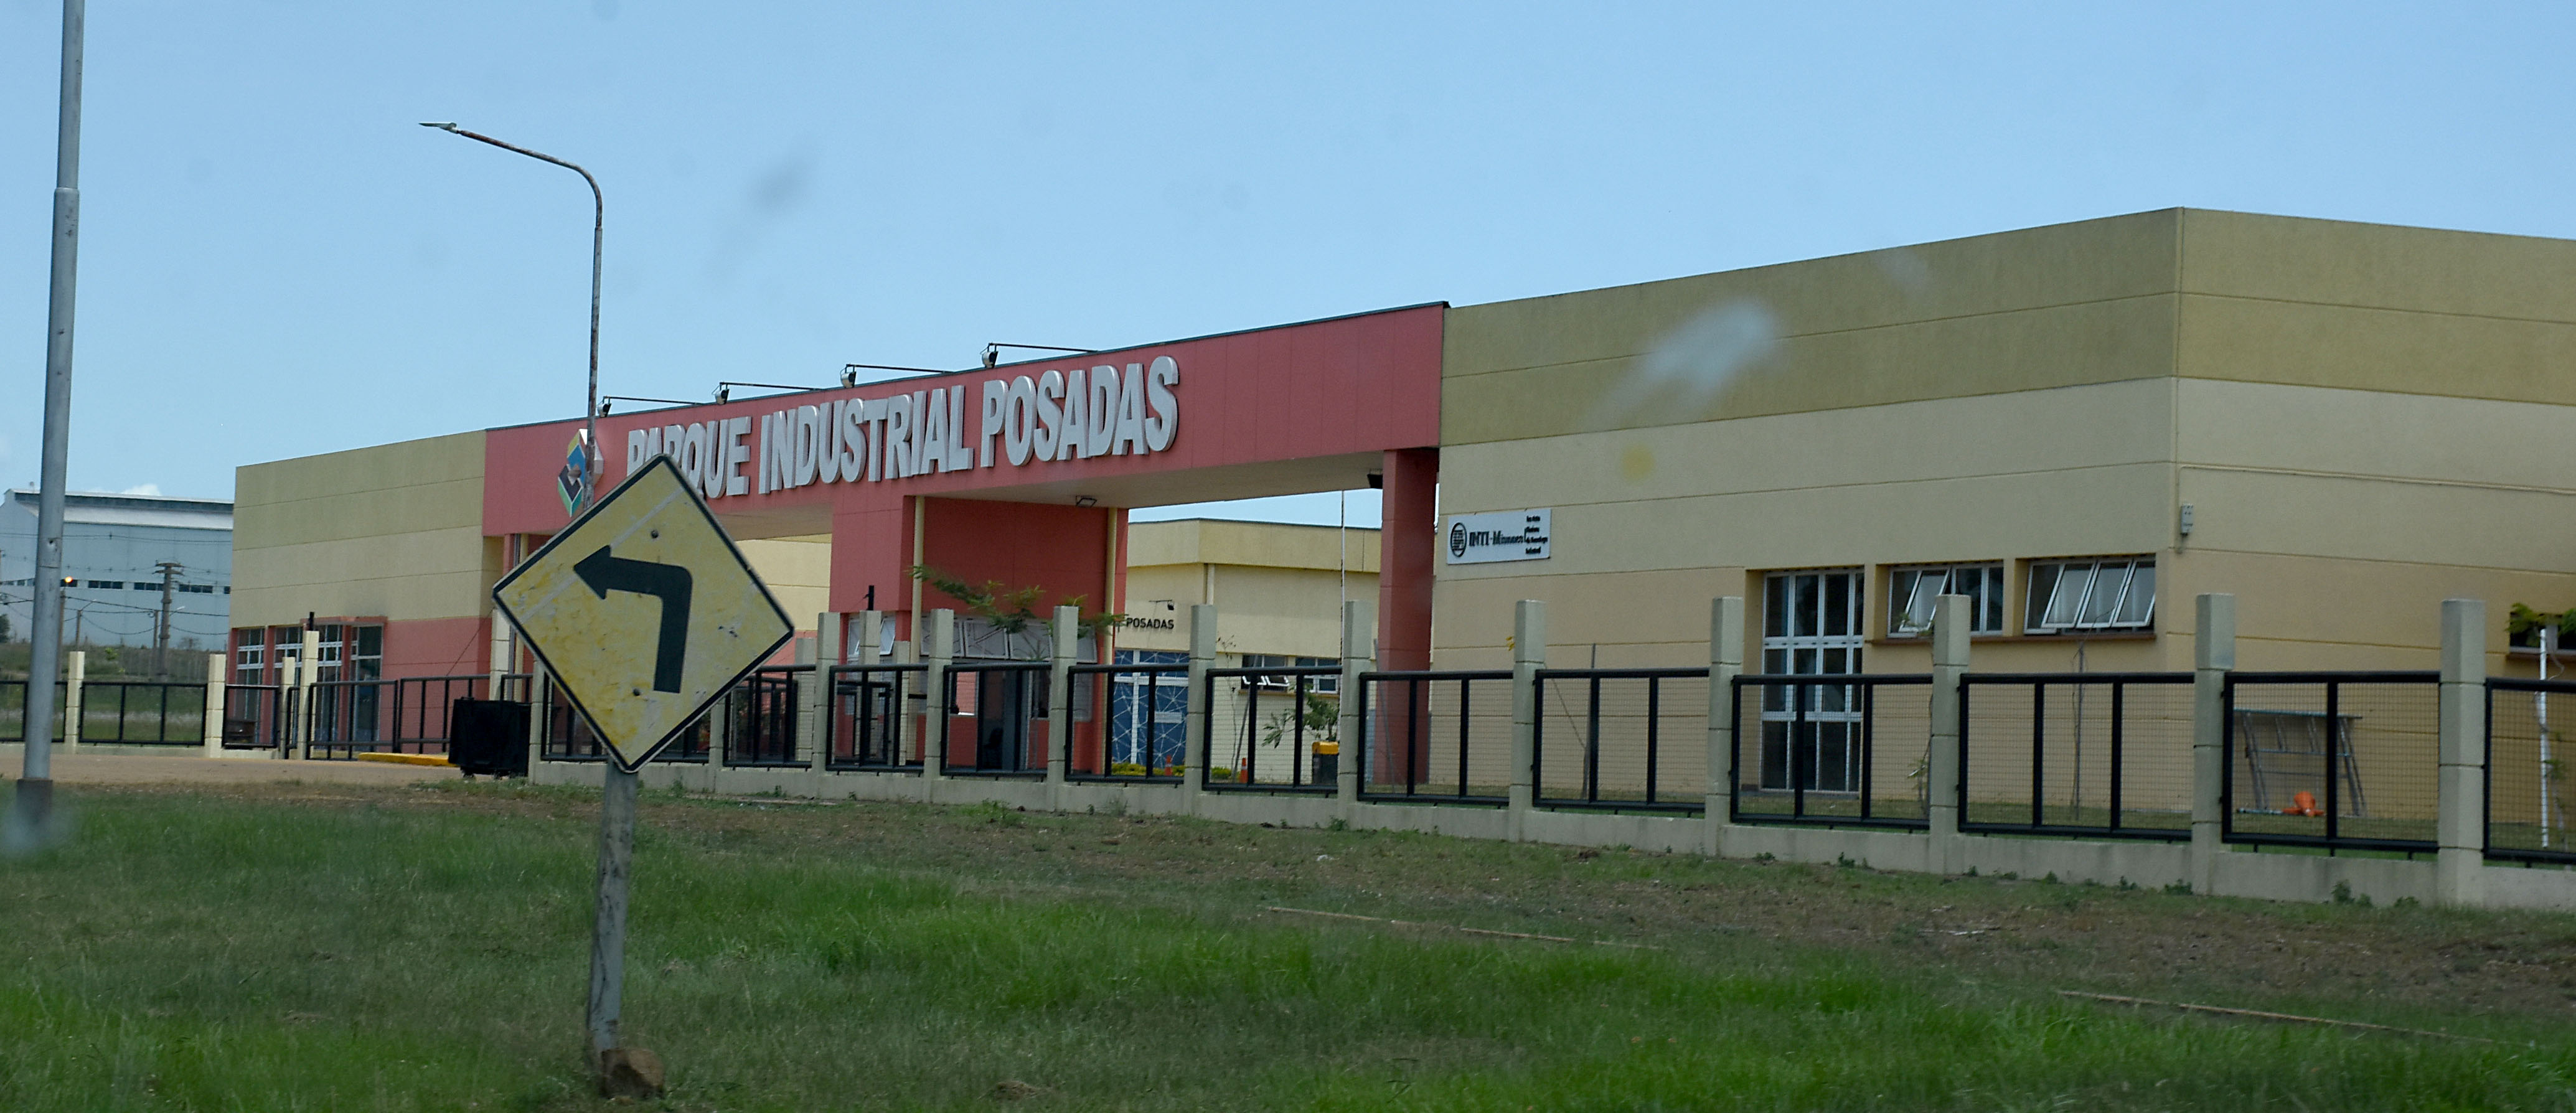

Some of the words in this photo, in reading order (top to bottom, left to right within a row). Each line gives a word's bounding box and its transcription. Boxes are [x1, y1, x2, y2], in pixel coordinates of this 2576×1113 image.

[758, 385, 974, 495] INDUSTRIAL
[980, 355, 1178, 467] POSADAS
[1126, 618, 1175, 630] POSADAS
